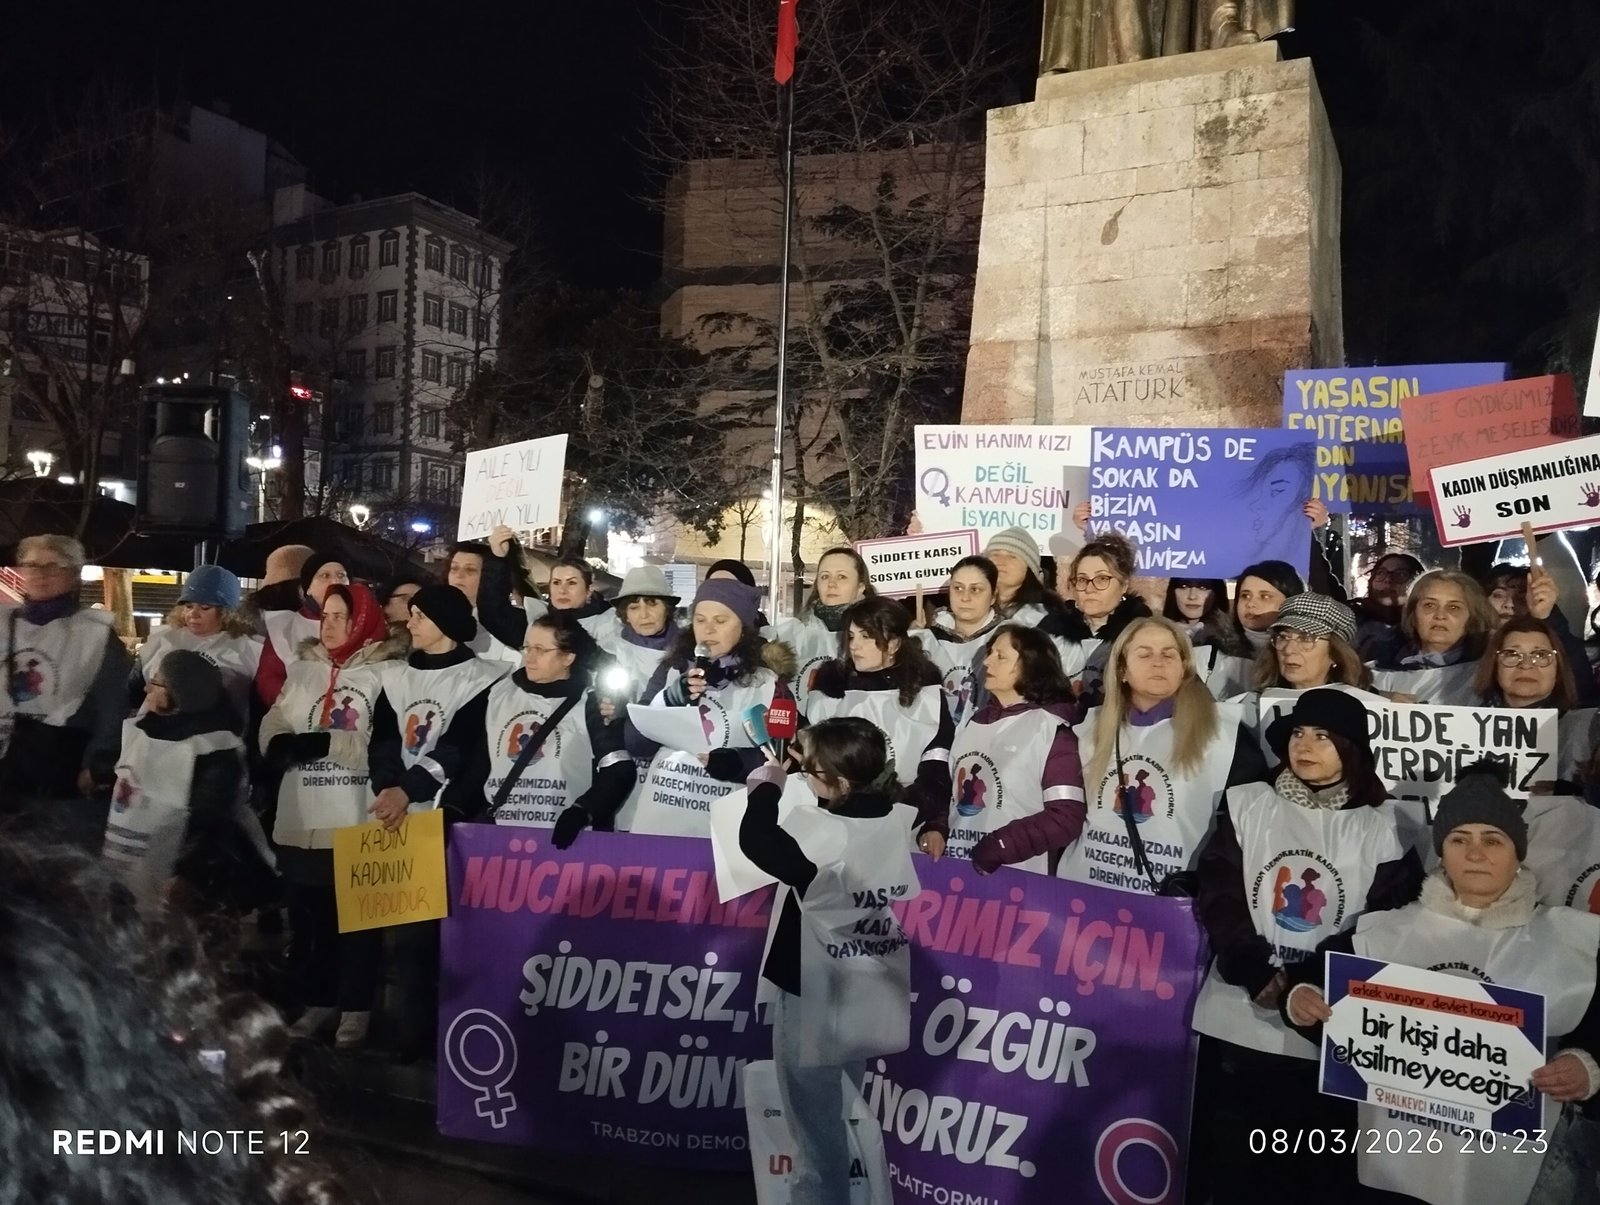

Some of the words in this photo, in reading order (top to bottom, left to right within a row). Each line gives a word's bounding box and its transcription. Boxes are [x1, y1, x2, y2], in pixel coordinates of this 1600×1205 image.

[1078, 366, 1136, 381] MUSTAFA
[1139, 362, 1184, 376] KEMAL
[1075, 376, 1185, 405] ATATÜRK
[923, 430, 969, 450] EVİN
[976, 432, 1033, 450] HANIM
[1038, 434, 1072, 452] KIZI
[1093, 430, 1212, 464] KAMPÜS
[1224, 438, 1257, 461] DE
[975, 461, 1034, 484] DEĞİL
[1091, 466, 1159, 489] SOKAK
[1168, 467, 1199, 489] DA
[1441, 474, 1487, 499] KADIN
[1487, 453, 1600, 490] DÜŞMANLIĞINA
[955, 485, 1071, 510] KAMPÜSÜN
[1090, 492, 1158, 518] BİZİM
[1495, 494, 1552, 518] SON
[961, 506, 1056, 531] İSYANCISI
[924, 546, 962, 559] KARŞI
[870, 570, 913, 583] SOSYAL
[1472, 711, 1539, 750] YAN
[360, 821, 409, 854] KADIN
[350, 858, 414, 889] KADININ
[1252, 869, 1266, 910] TRABZON
[1263, 848, 1315, 872] DEMOKRATİK
[1314, 853, 1340, 879] KADIN
[1334, 876, 1346, 929] PLATFORMU
[1053, 898, 1175, 1000] İÇİN.
[1352, 984, 1382, 1000] erkek
[1432, 997, 1469, 1014] devlet
[518, 940, 750, 1033] ŞİDDETSİZ,
[922, 974, 1097, 1088] ÖZGÜR
[1361, 1006, 1394, 1041] bir
[1399, 1015, 1439, 1057] kişi
[1443, 1027, 1508, 1067] daha
[558, 1029, 632, 1099] BİR
[1429, 1102, 1475, 1125] KADINLAR
[590, 1120, 680, 1149] TRABZON
